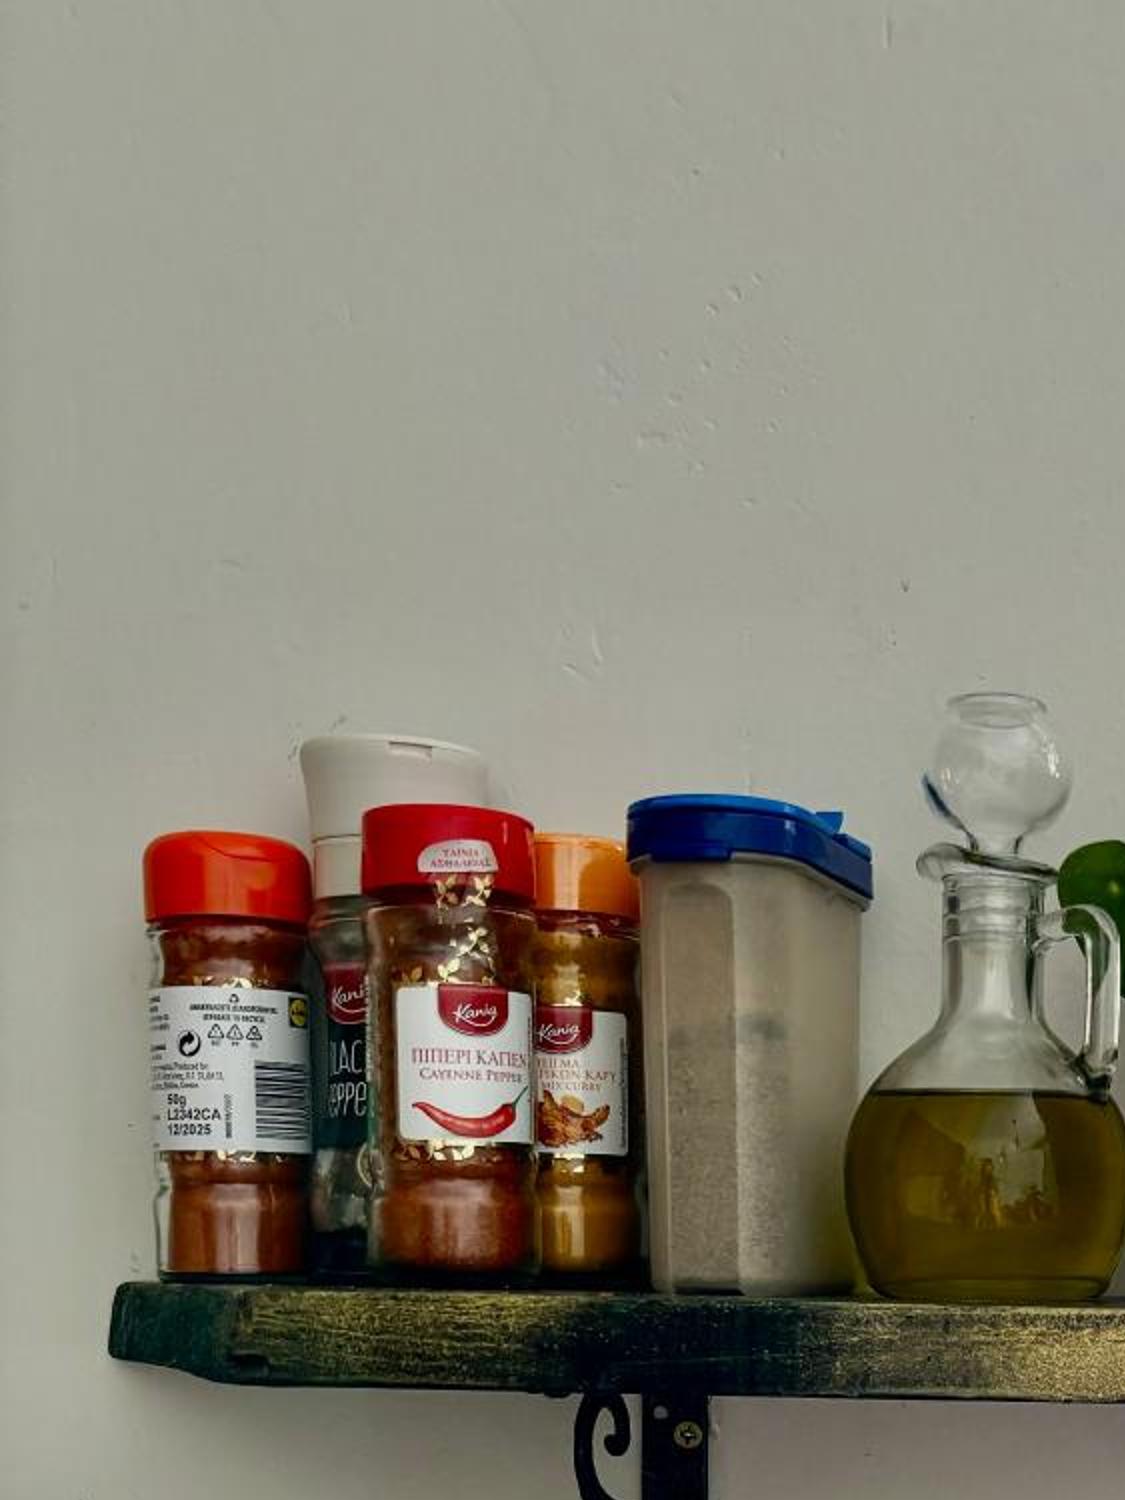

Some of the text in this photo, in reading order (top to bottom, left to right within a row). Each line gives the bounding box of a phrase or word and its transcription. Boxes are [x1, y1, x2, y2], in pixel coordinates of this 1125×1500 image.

[331, 984, 366, 1013] Kani
[452, 1003, 497, 1027] Kania
[167, 1093, 187, 1107] 50g
[167, 1107, 222, 1121] L2342CA
[168, 1123, 212, 1136] 12/2025
